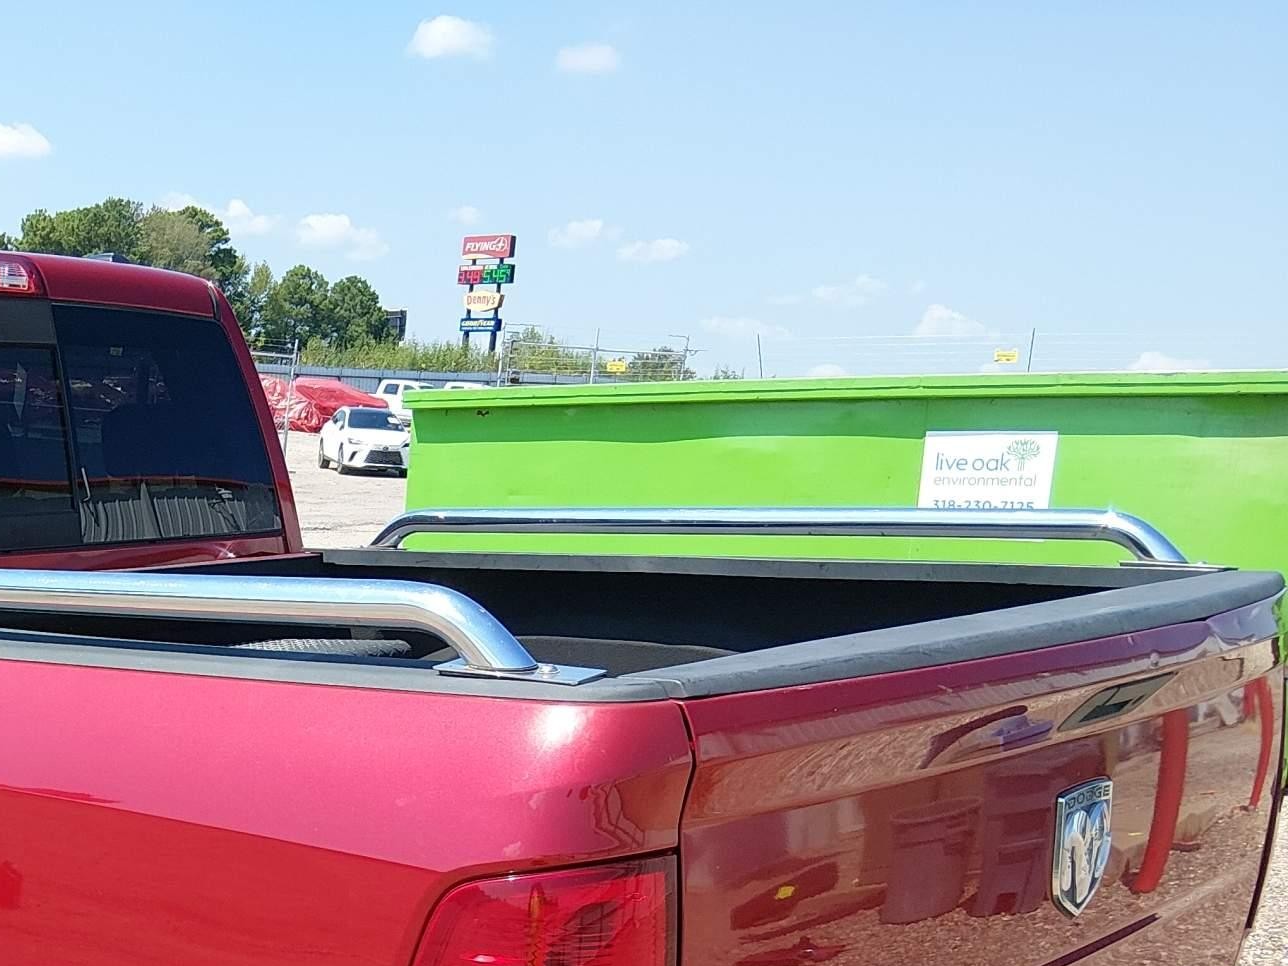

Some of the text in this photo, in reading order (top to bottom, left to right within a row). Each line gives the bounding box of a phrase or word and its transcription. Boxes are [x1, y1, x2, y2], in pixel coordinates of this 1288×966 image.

[465, 241, 496, 251] FLYING
[467, 295, 496, 306] Denny's
[935, 452, 1011, 471] live oak
[933, 473, 1038, 487] environmental
[1065, 784, 1111, 809] DODGE
